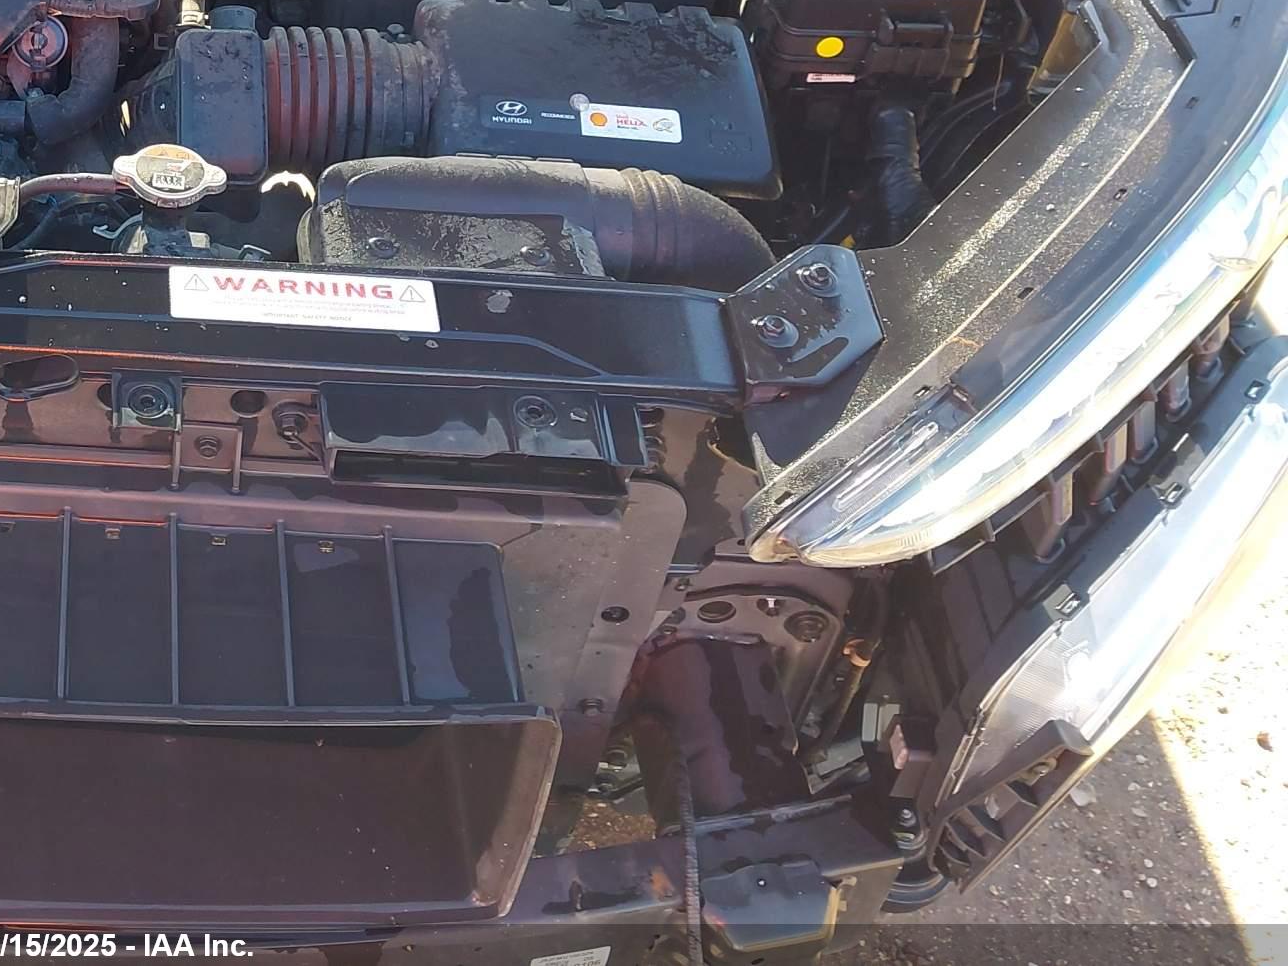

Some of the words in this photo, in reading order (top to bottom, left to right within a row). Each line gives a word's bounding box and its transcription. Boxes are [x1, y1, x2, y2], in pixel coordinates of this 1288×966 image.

[492, 116, 532, 125] HYUNDAI
[616, 117, 647, 127] HELIX
[213, 275, 394, 300] WARNING
